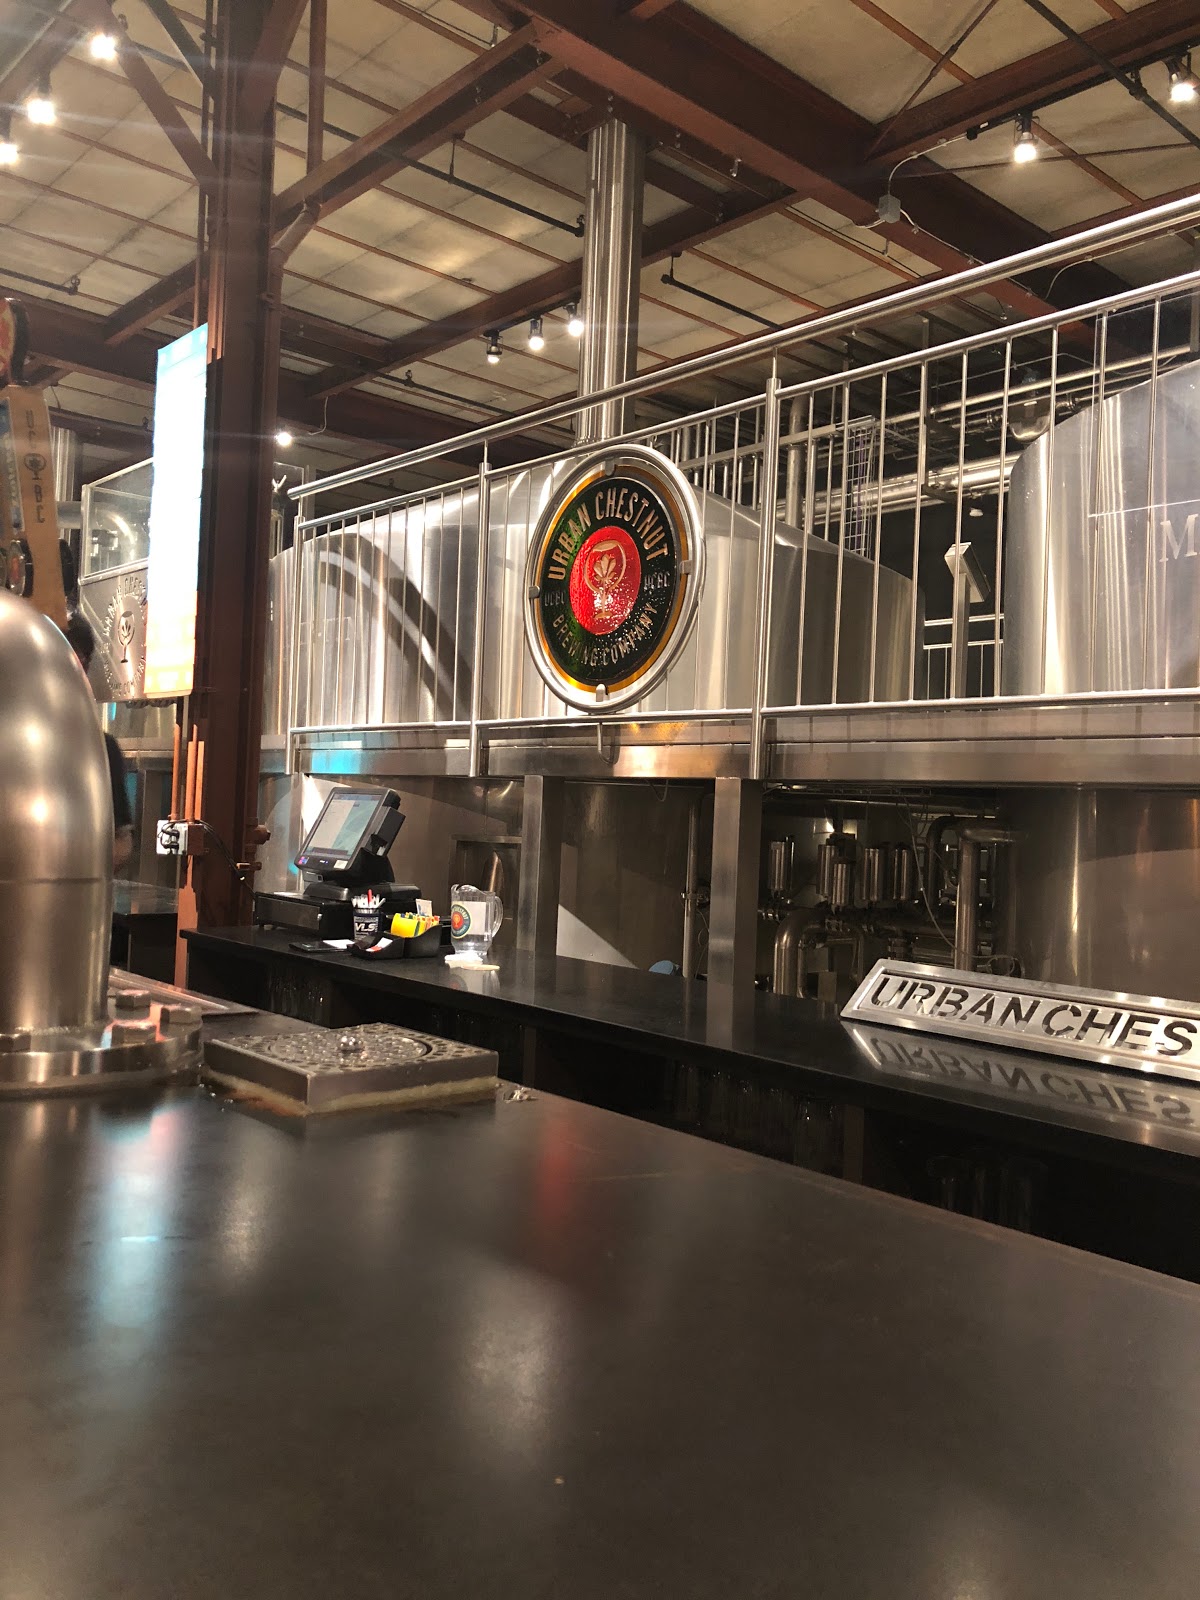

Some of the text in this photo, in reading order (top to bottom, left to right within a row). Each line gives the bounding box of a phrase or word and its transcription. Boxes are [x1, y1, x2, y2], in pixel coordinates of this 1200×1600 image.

[547, 487, 669, 580] URBAN CHESTNUT
[602, 602, 658, 666] COMPANY
[870, 977, 1199, 1057] URBAN CHES
